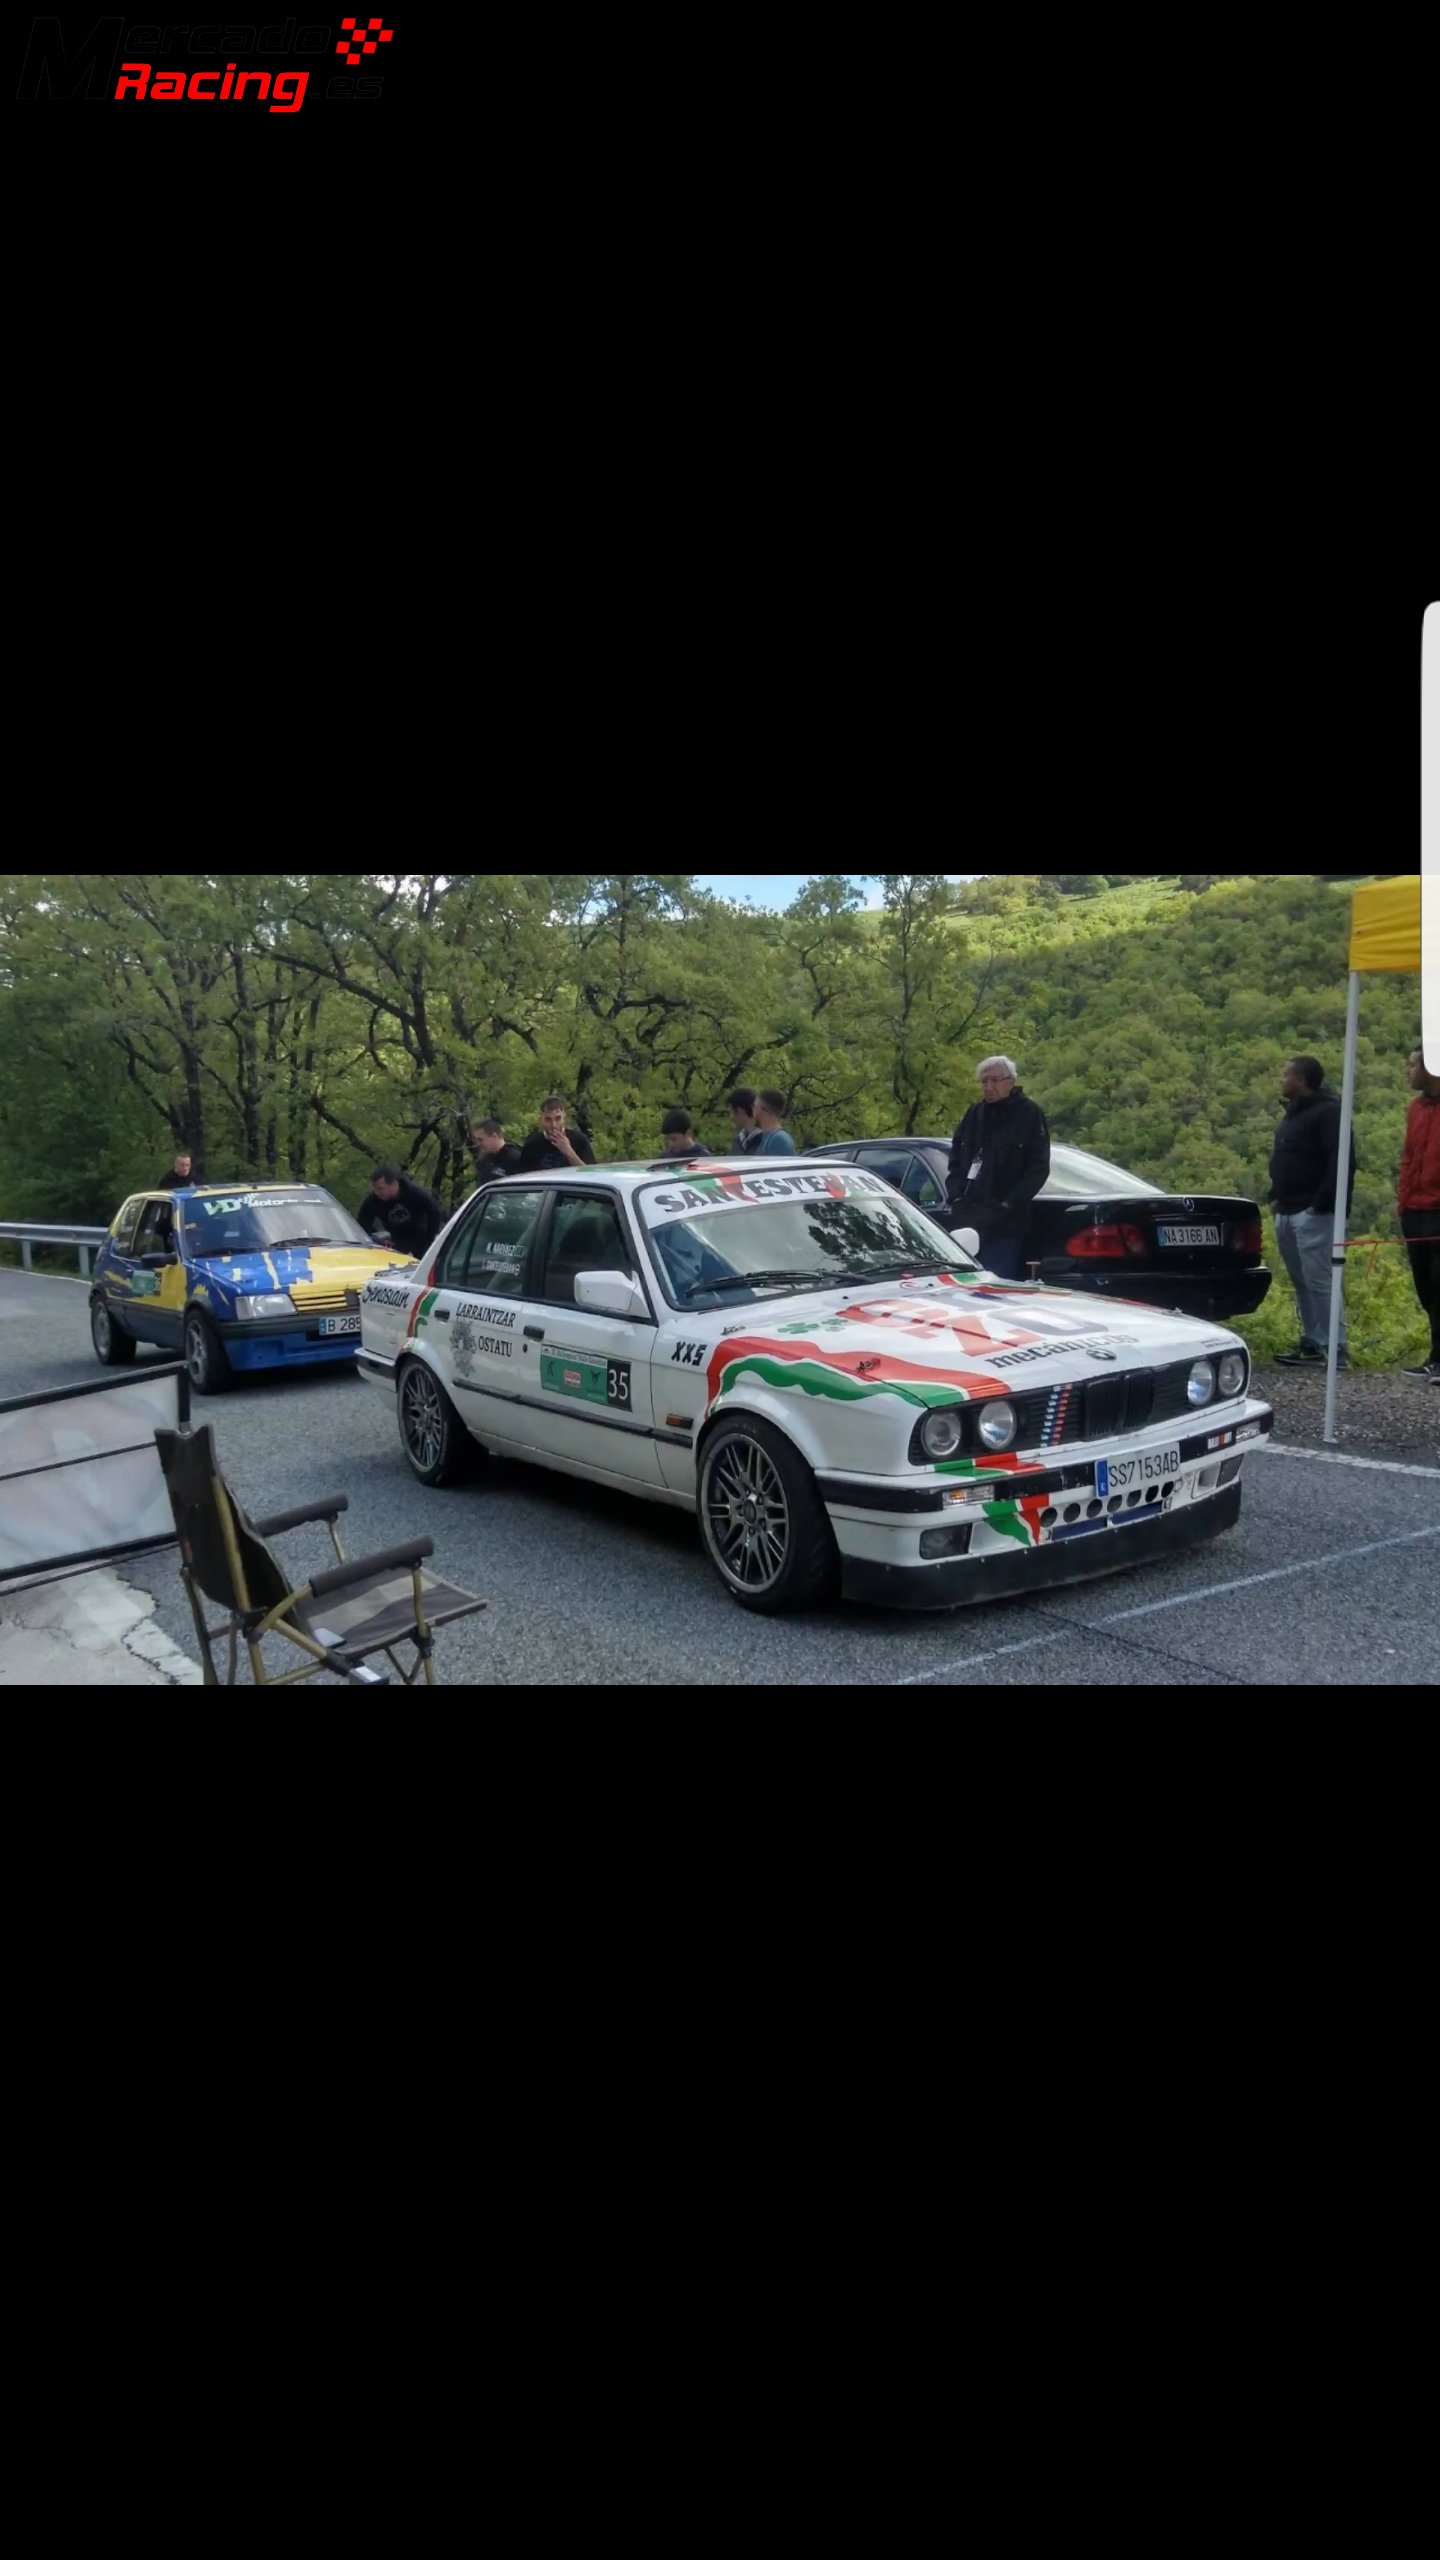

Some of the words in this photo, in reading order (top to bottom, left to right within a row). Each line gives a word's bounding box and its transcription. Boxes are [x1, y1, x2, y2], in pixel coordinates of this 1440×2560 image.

[655, 1173, 887, 1213] SANTESTEBAN
[328, 1319, 336, 1332] B
[456, 1302, 516, 1328] LARRAINTZAR
[478, 1335, 513, 1357] OSTATU
[608, 1369, 629, 1400] 35
[1108, 1450, 1180, 1488] SS7153AB
